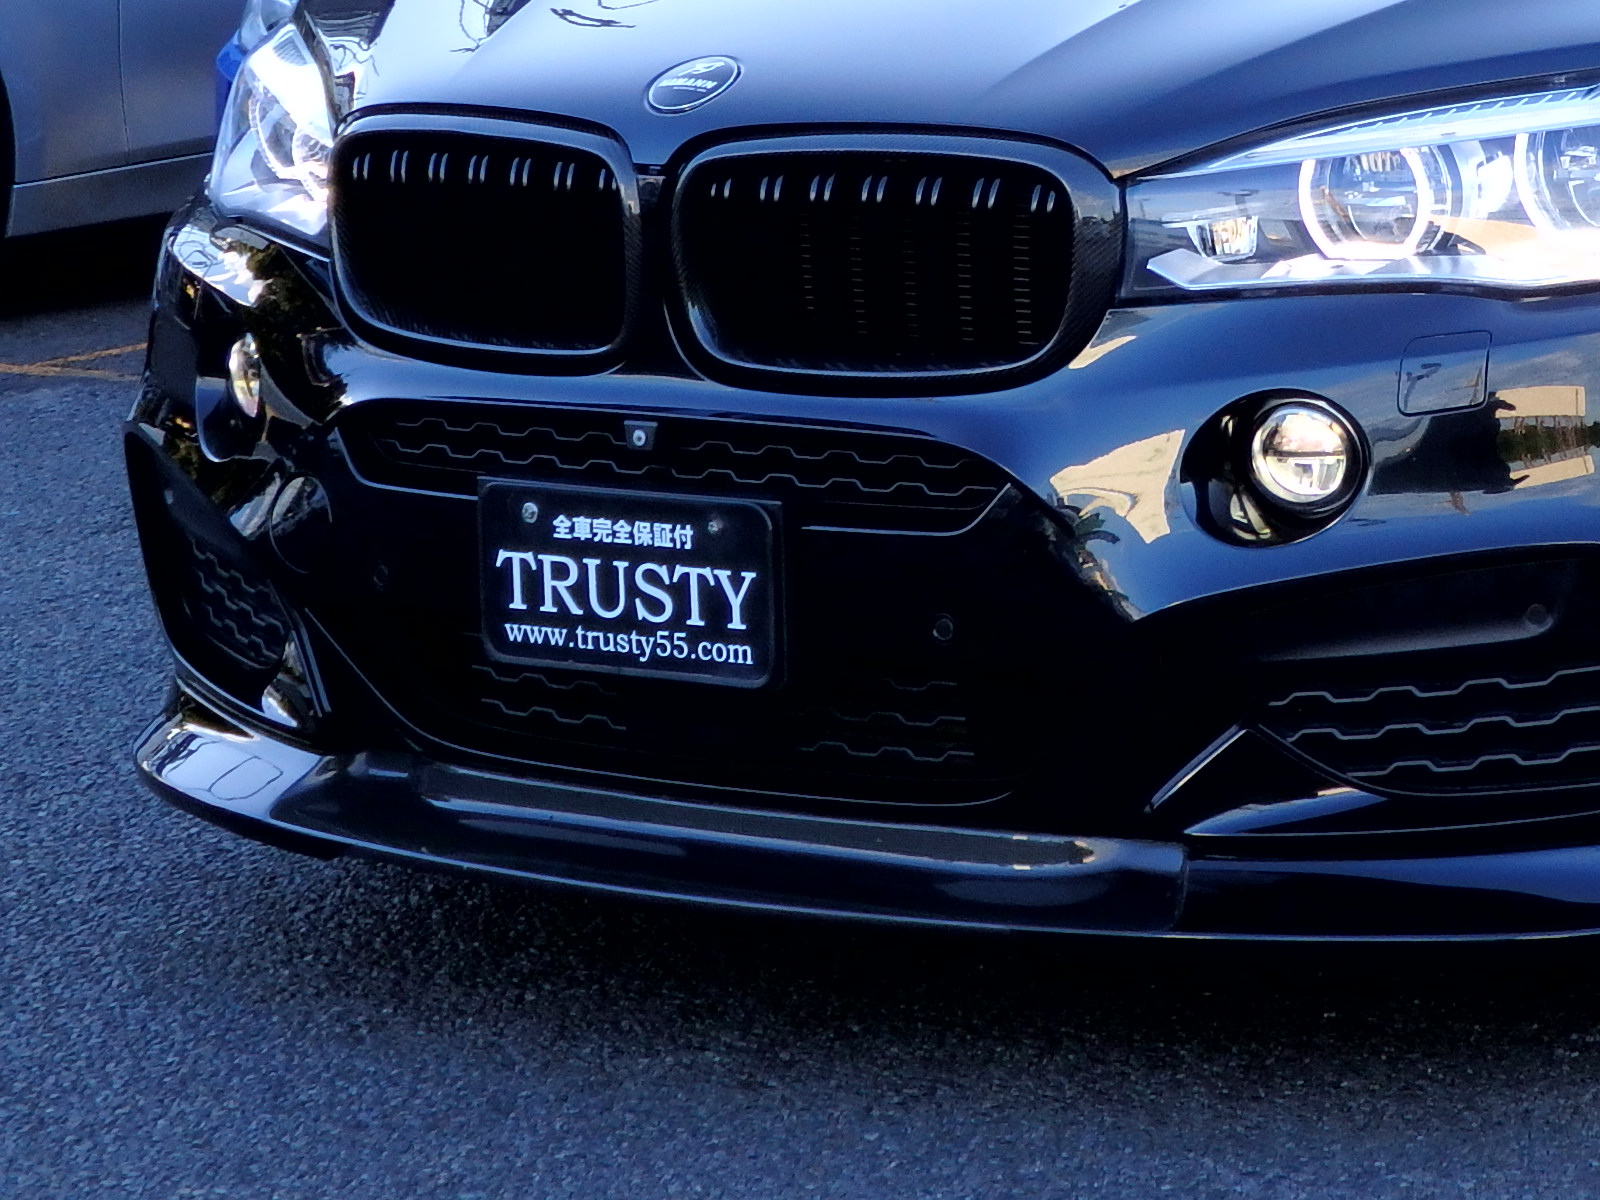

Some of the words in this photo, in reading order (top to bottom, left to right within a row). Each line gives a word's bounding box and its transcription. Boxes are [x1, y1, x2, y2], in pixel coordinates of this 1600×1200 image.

[552, 514, 693, 549] 全車完全保証付
[495, 548, 756, 630] TRUSTY
[504, 622, 754, 665] www.trusty55.com
